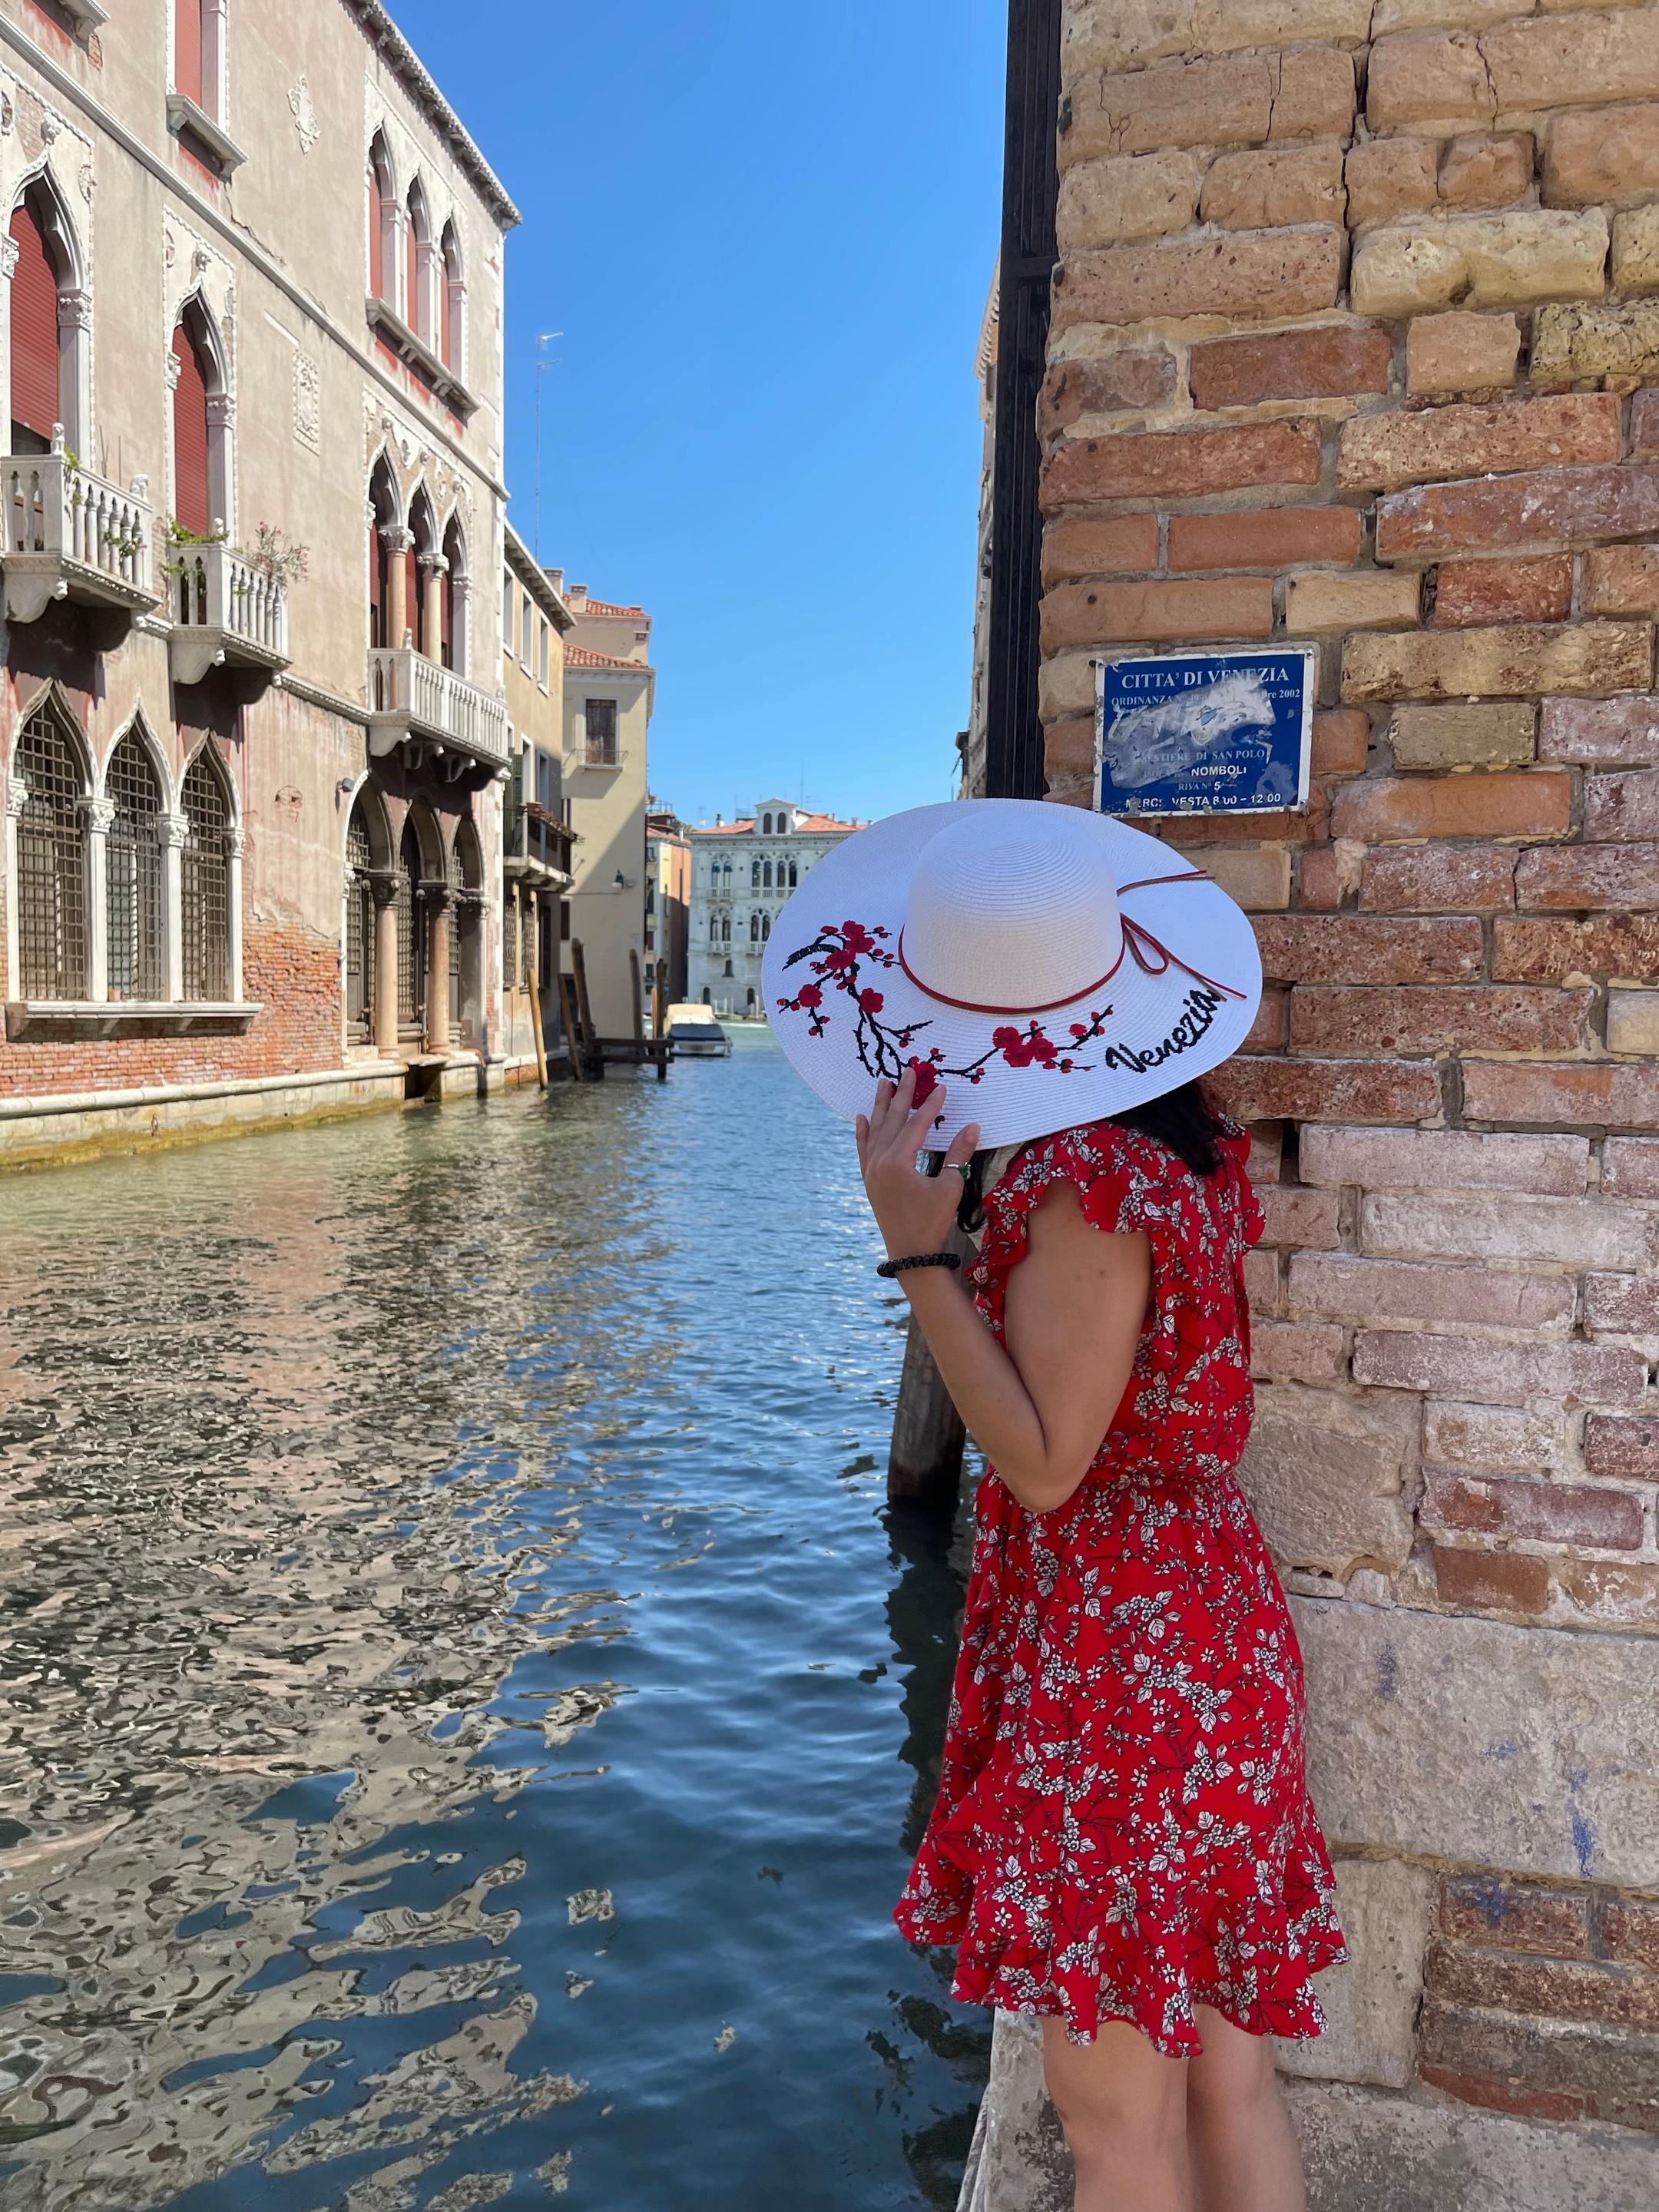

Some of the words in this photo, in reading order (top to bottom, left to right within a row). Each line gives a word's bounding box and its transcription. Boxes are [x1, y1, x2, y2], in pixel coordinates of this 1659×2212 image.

[1121, 673, 1179, 688] CITTA'
[1184, 671, 1203, 686] DI
[1208, 667, 1290, 684] VENEZIA
[1111, 695, 1173, 706] ORDINANZA
[1279, 690, 1300, 698] 2002
[1197, 751, 1207, 760] DI
[1212, 750, 1233, 760] SAN
[1236, 750, 1265, 759] POLO
[1191, 765, 1247, 777] NOMBOLI
